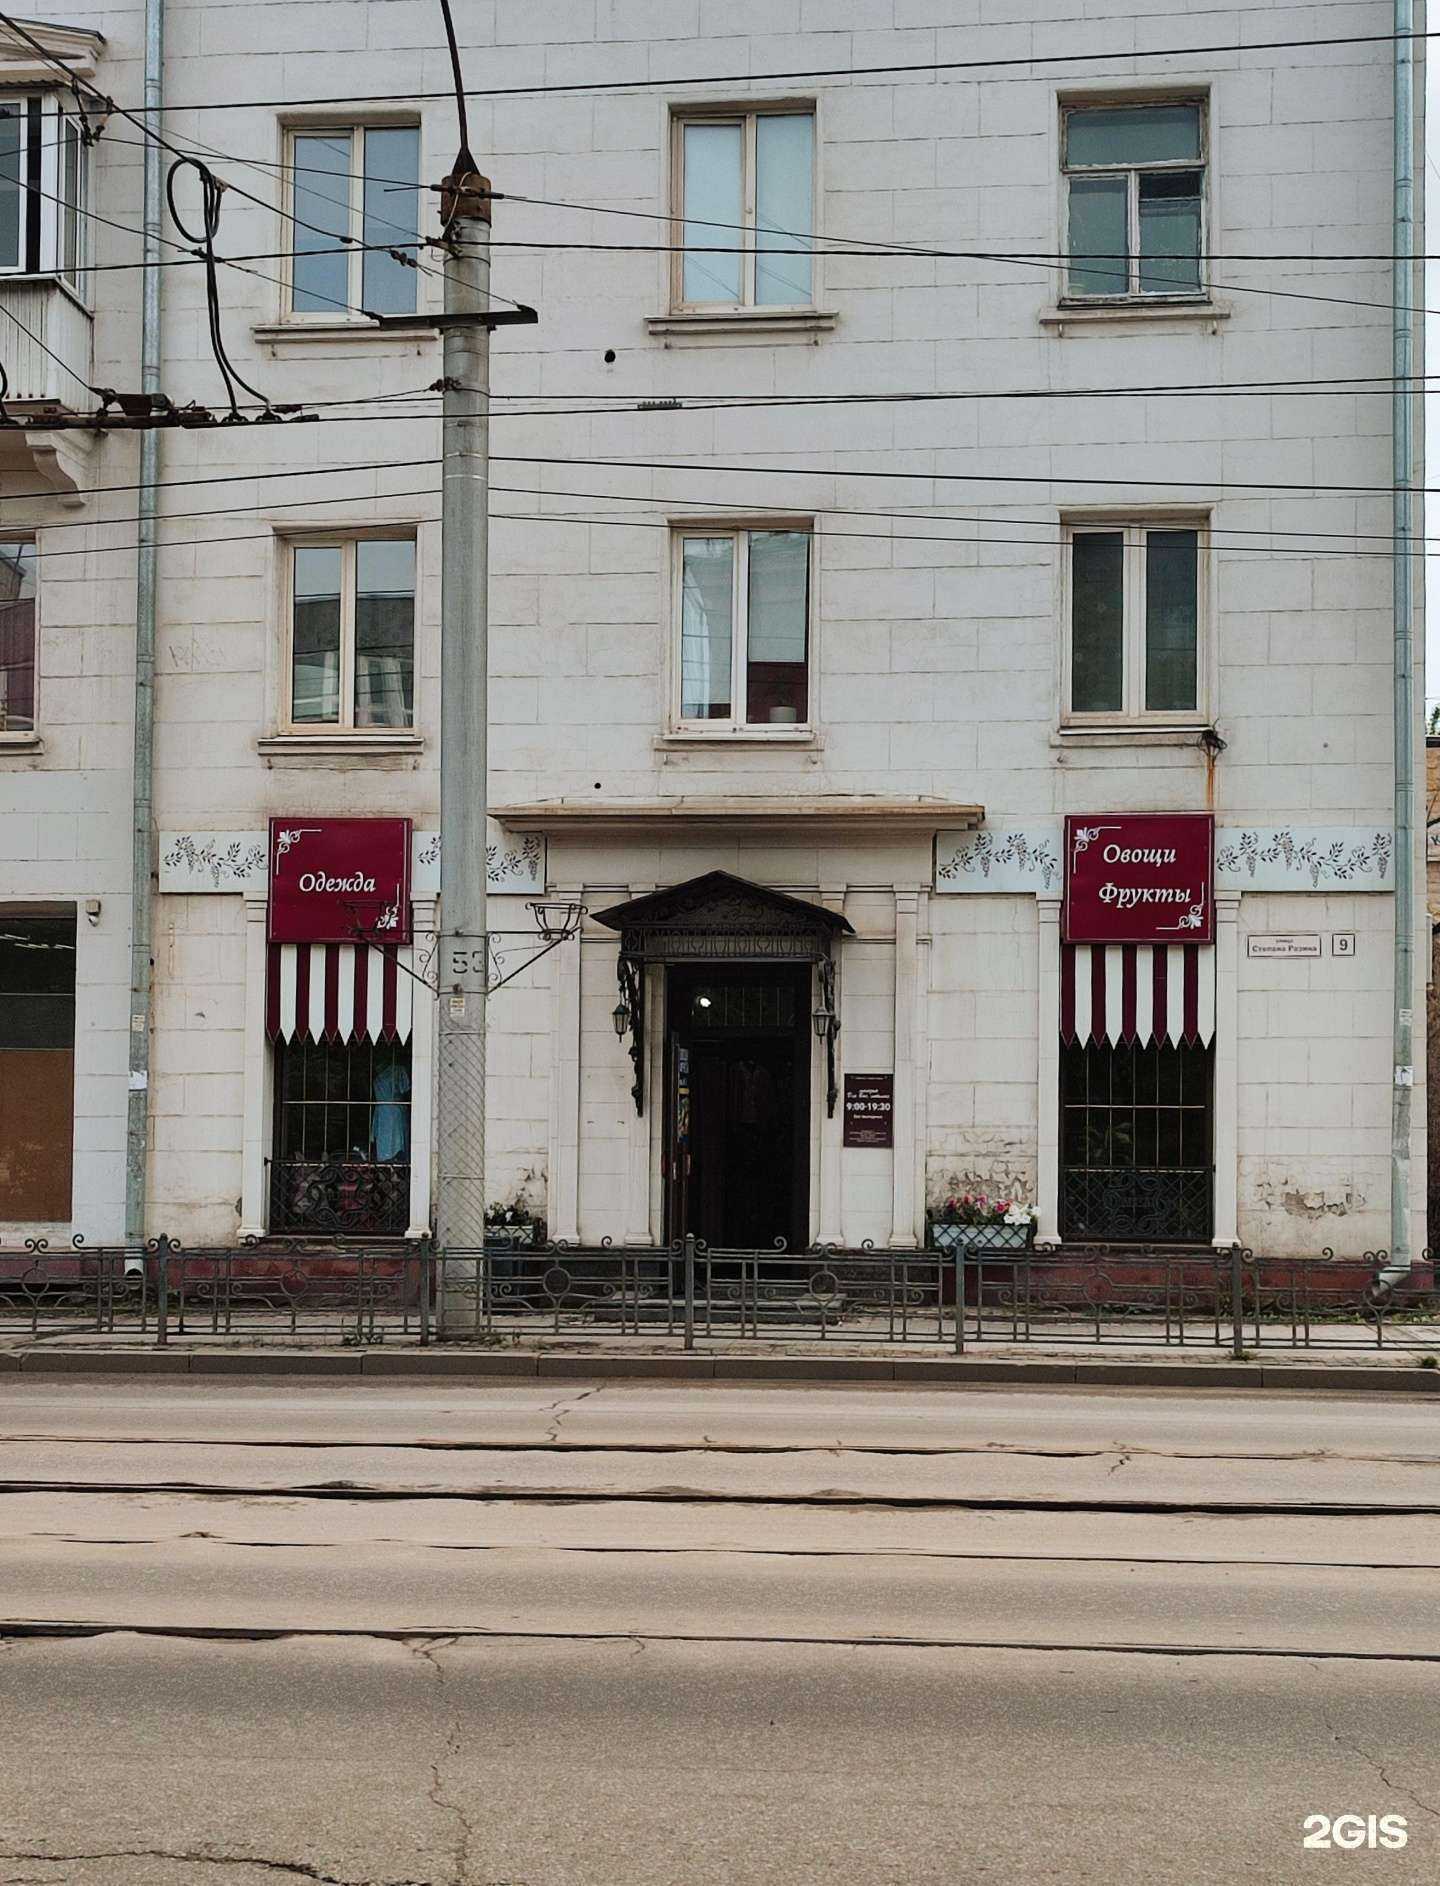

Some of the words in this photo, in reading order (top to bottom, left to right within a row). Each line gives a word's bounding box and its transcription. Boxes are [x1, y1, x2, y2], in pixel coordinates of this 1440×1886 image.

[1103, 844, 1176, 867] Овощи
[299, 871, 376, 892] Одежда
[1098, 882, 1191, 908] Фрукты
[1339, 938, 1348, 951] 9
